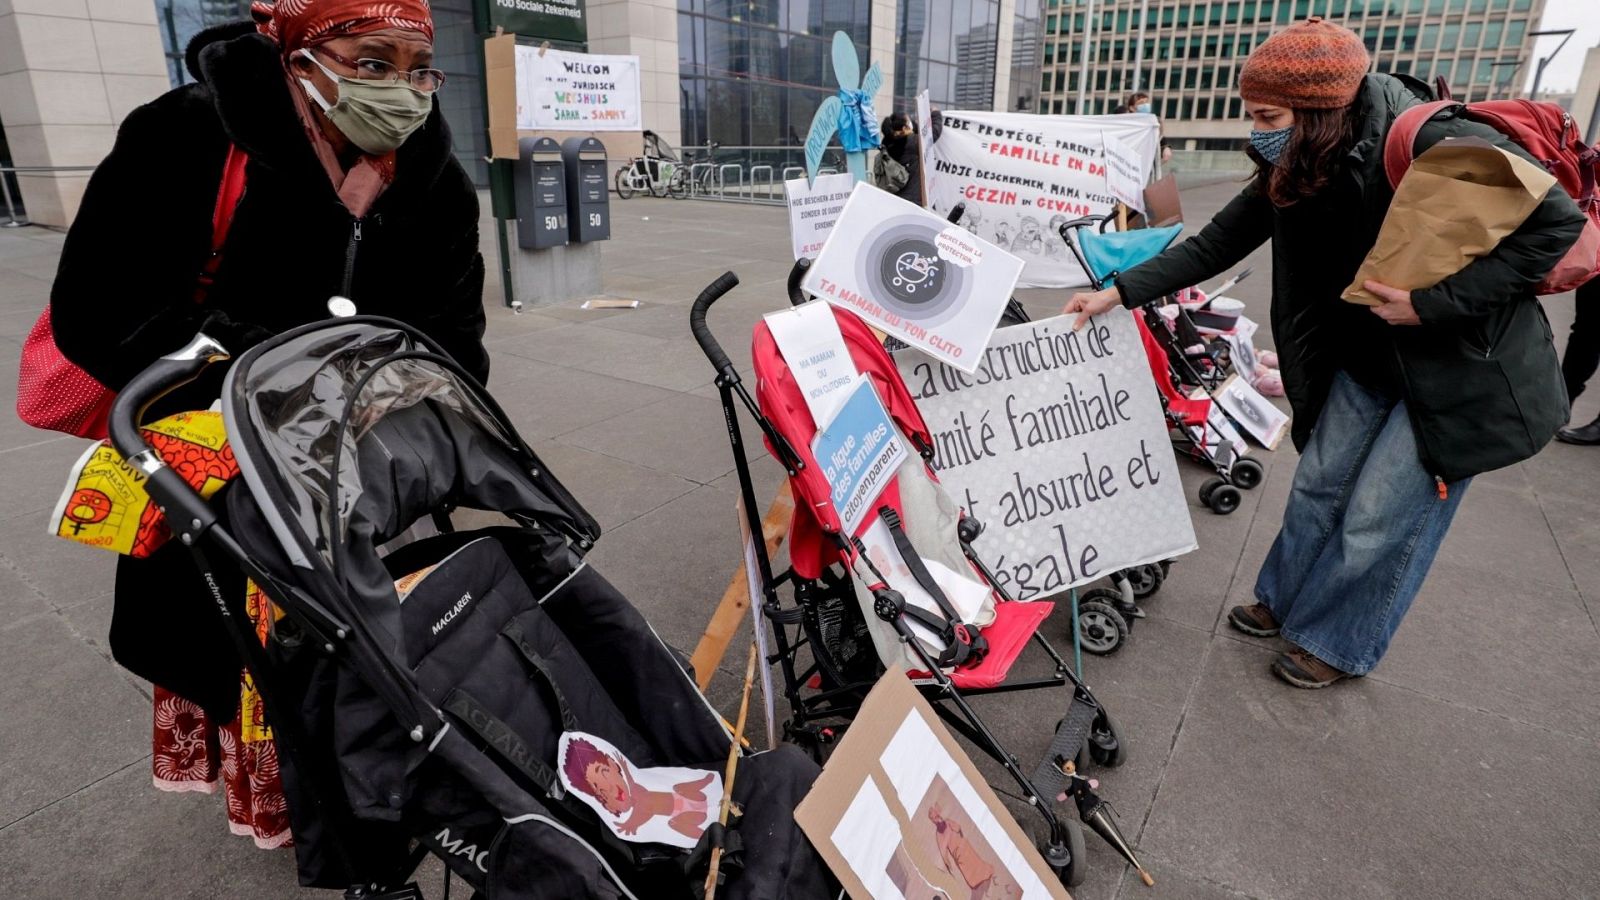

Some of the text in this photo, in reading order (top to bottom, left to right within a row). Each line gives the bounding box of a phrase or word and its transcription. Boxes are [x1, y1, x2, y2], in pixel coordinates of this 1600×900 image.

[515, 0, 544, 12] Sociale
[544, 4, 581, 18] Zekerheid
[563, 61, 610, 75] WELKOM
[572, 81, 615, 90] JURIDISCH
[592, 110, 626, 120] SAMMY
[806, 103, 838, 167] VROUWEN
[943, 116, 971, 131] EBE
[1056, 140, 1095, 156] PARENT
[934, 159, 972, 178] INDJE
[1051, 183, 1080, 199] MAMA
[1068, 156, 1083, 172] EN
[1088, 163, 1105, 177] DA
[589, 213, 601, 226] 50
[800, 209, 820, 219] ZONDER
[1037, 198, 1090, 216] GEVAAR
[545, 216, 558, 230] 50
[802, 244, 809, 253] JE
[940, 233, 958, 244] MERCI
[959, 242, 973, 253] POUR
[819, 278, 963, 358] TA MAMAN OU TON CLITO
[1086, 316, 1113, 359] de
[799, 350, 835, 369] MA MAMAN
[816, 369, 827, 379] OU
[822, 376, 851, 393] CLITORIS
[1005, 373, 1131, 451] familiale
[831, 434, 856, 469] ligue
[834, 422, 888, 503] des familles
[844, 441, 898, 523] citoyenparent
[999, 452, 1118, 528] absurde
[1127, 439, 1160, 489] et
[994, 523, 1102, 600] égale
[431, 591, 473, 636] MACLAREN
[451, 699, 552, 788] ACLAREN
[435, 828, 489, 873] MAC
